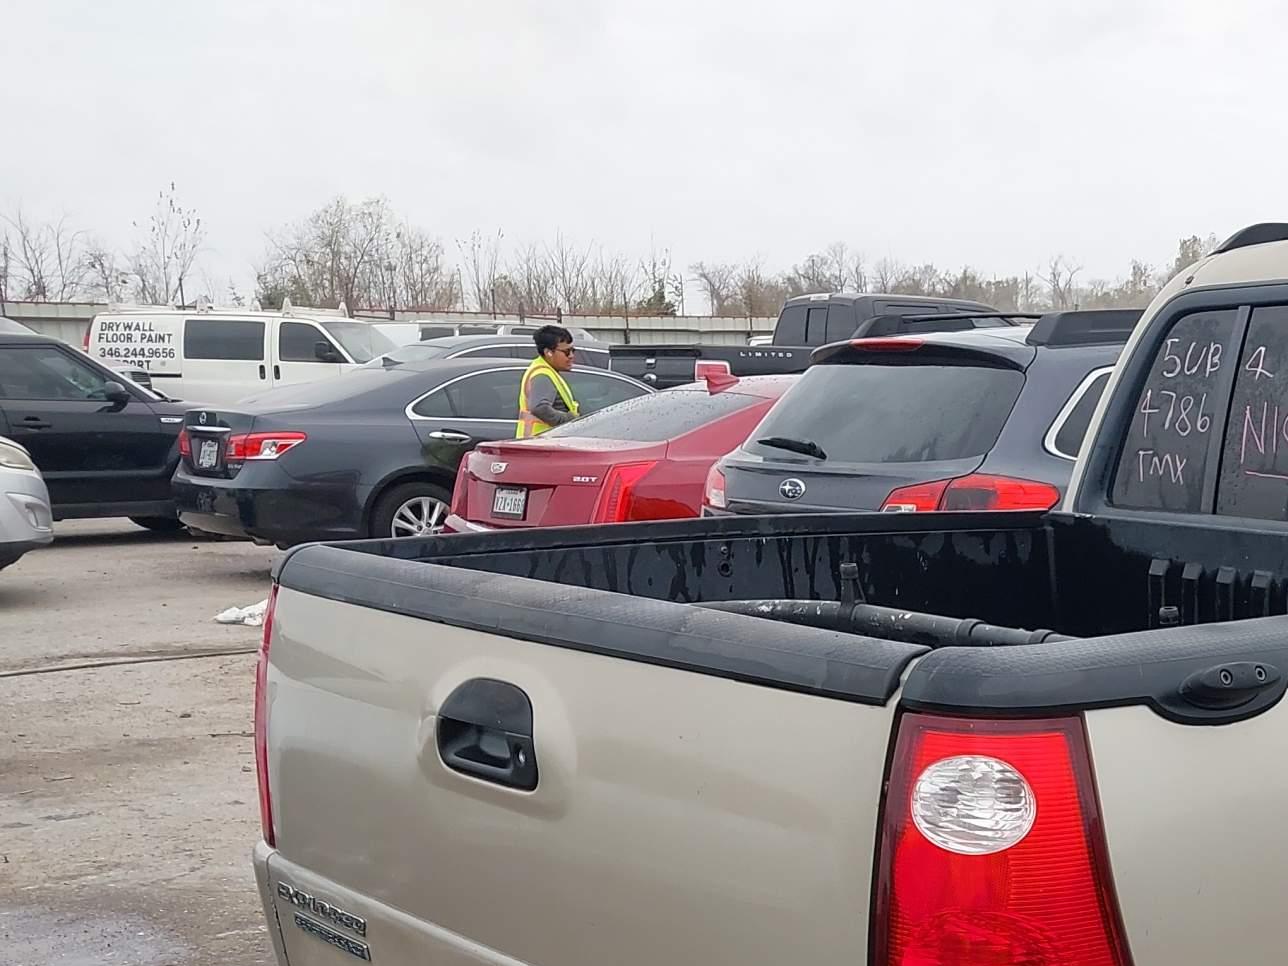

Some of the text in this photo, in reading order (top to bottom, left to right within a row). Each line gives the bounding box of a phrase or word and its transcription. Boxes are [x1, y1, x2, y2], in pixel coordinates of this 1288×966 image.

[98, 333, 173, 344] FLOOR. PAINT
[99, 347, 175, 358] 346.244.9656
